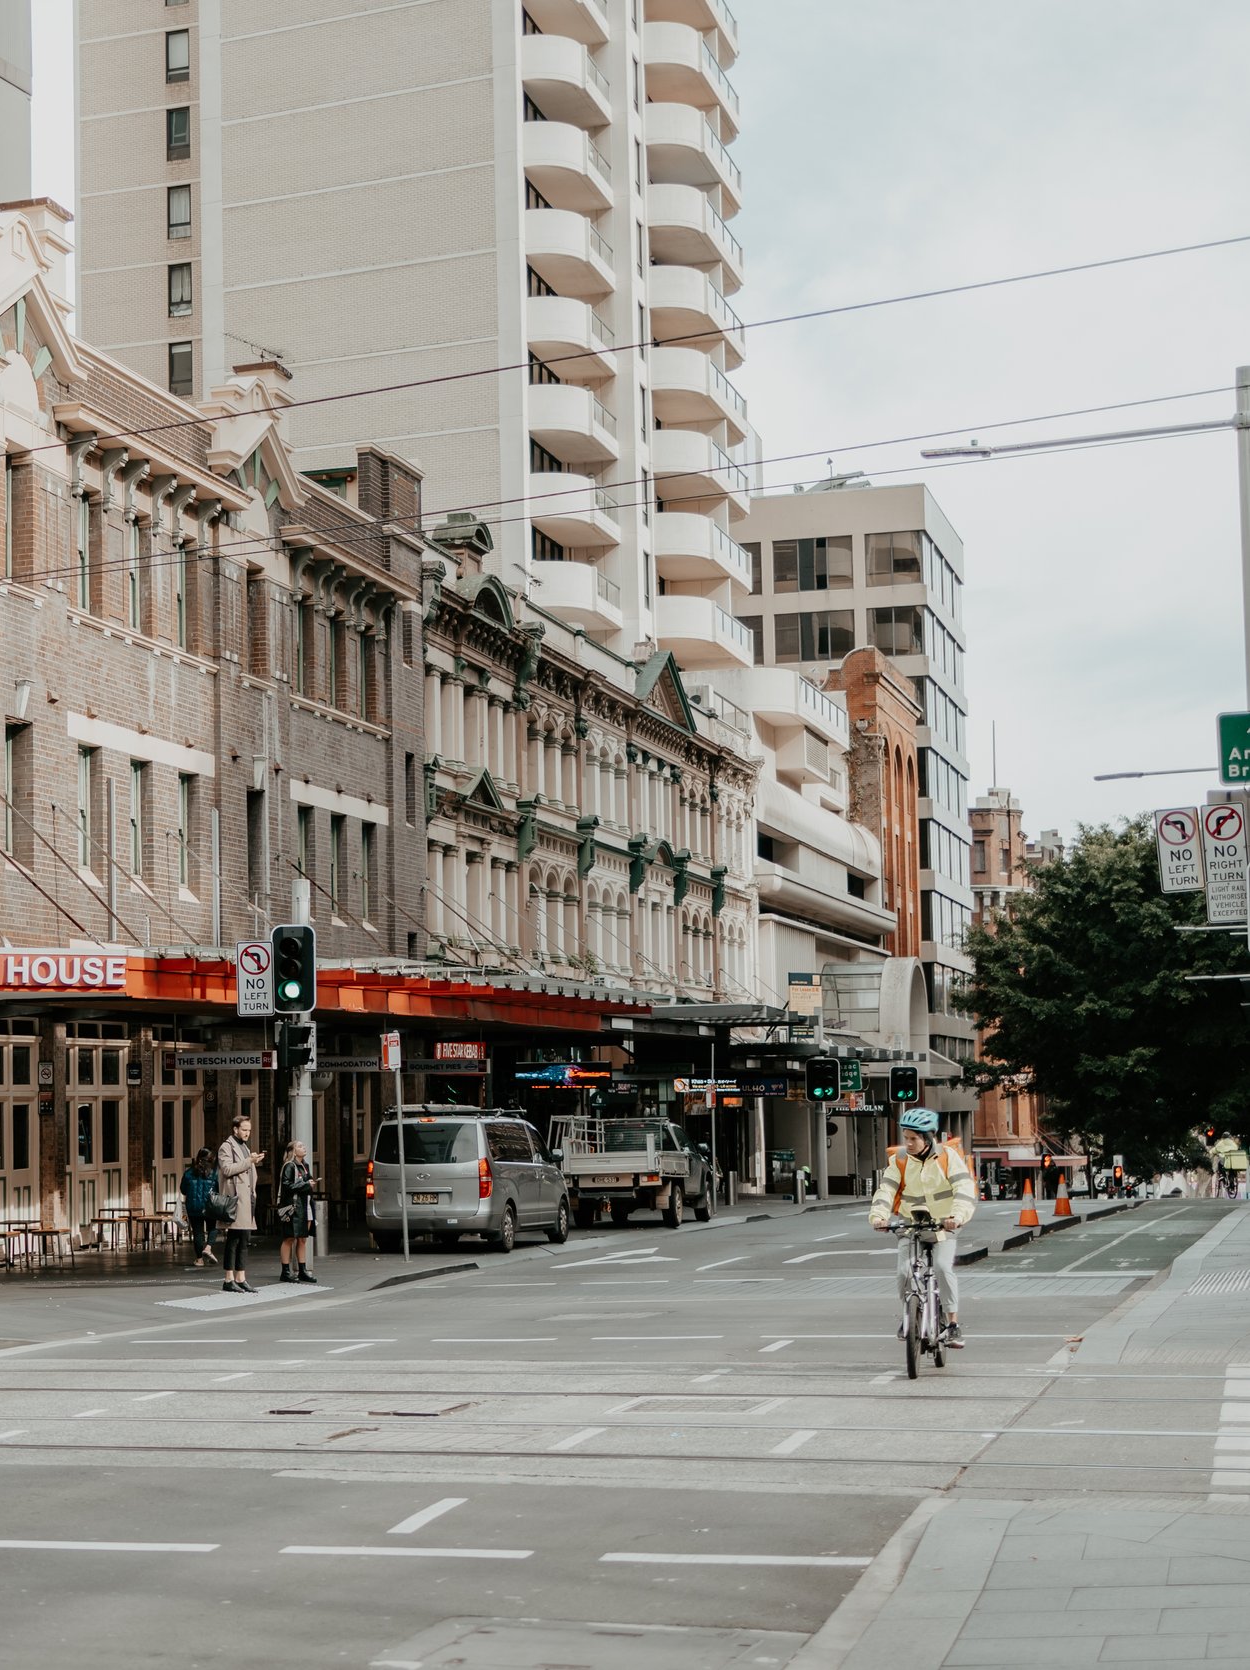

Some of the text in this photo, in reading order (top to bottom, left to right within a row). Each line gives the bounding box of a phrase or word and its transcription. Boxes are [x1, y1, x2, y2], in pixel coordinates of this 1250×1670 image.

[1170, 849, 1192, 862] NO
[1215, 845, 1237, 857] NO
[1169, 864, 1195, 874] LEFT
[1210, 860, 1243, 869] RIGHT
[1170, 876, 1199, 886] TURN
[1212, 872, 1243, 881] TURN
[1213, 909, 1248, 917] EXCEPTED
[6, 956, 126, 985] HOUSE
[246, 979, 265, 989] NO
[244, 992, 267, 1000] LEFT
[197, 1057, 227, 1065] RESCH
